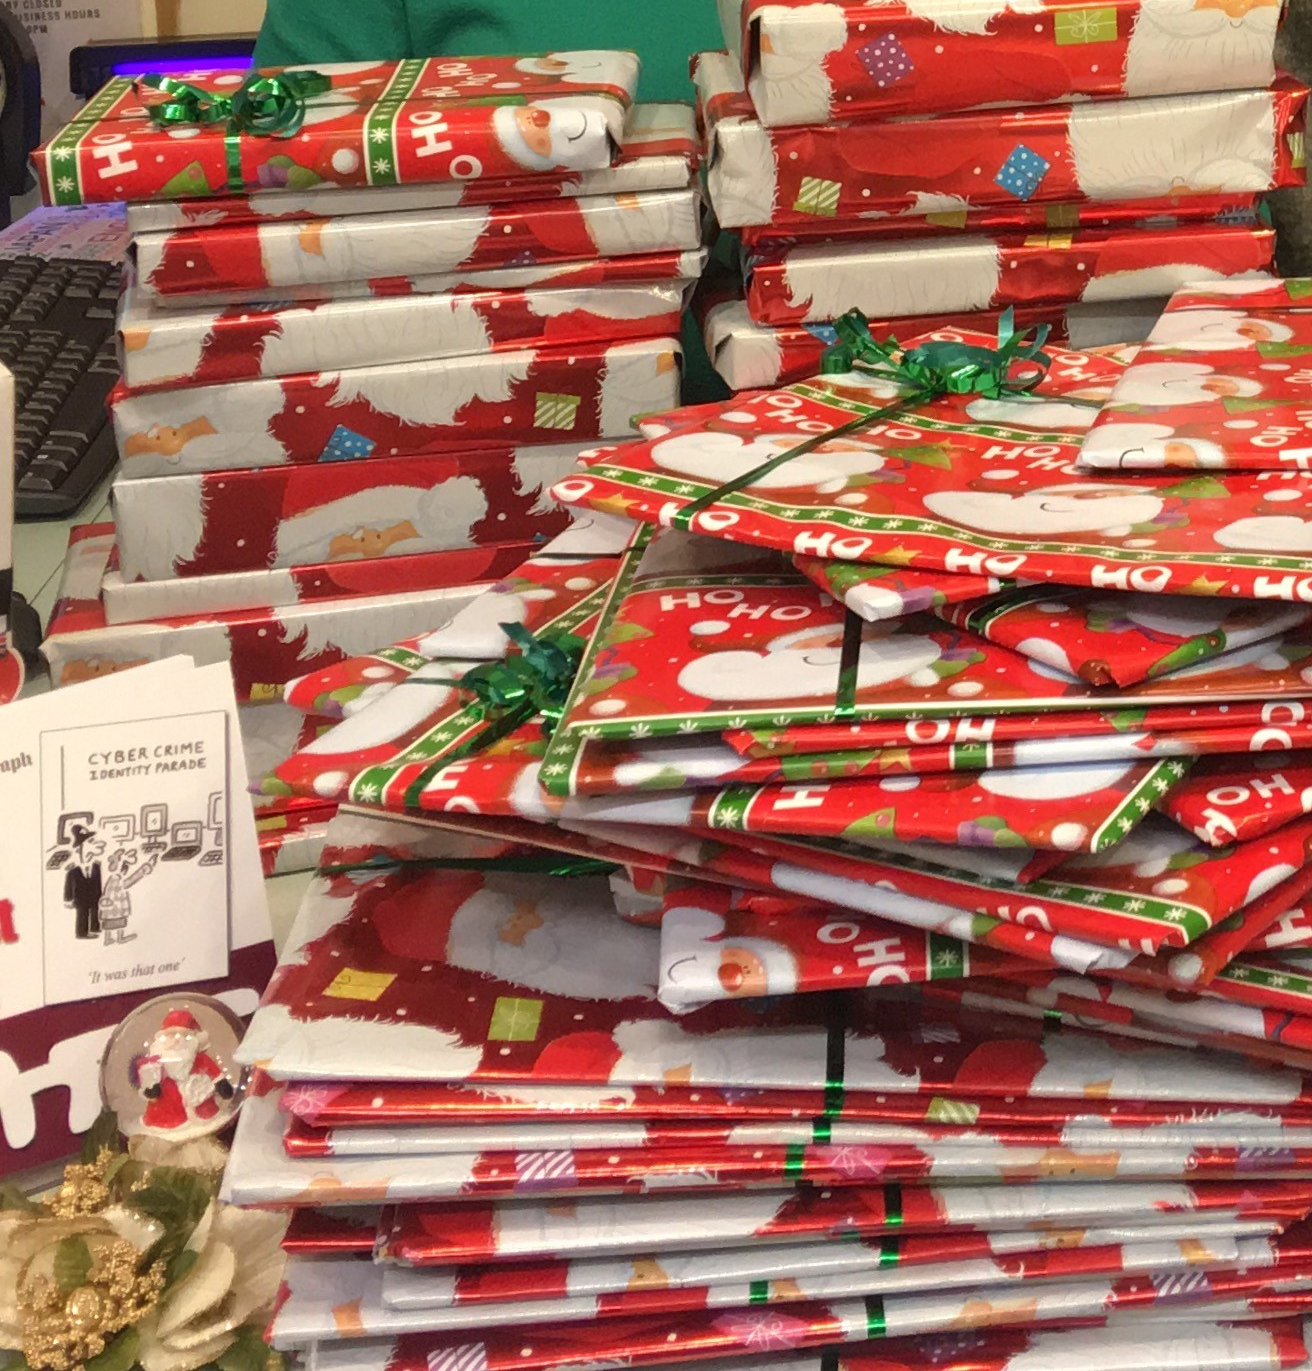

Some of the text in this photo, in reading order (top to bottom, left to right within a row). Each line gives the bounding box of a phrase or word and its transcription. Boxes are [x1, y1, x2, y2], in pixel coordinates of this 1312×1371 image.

[64, 8, 101, 20] HOURS
[793, 530, 873, 560] HO
[943, 547, 1028, 576] HO
[1090, 564, 1174, 594] HO
[87, 740, 206, 767] CYBER CRIME
[89, 757, 207, 781] IDENTITY PARADE
[104, 968, 128, 982] was
[131, 962, 156, 979] that
